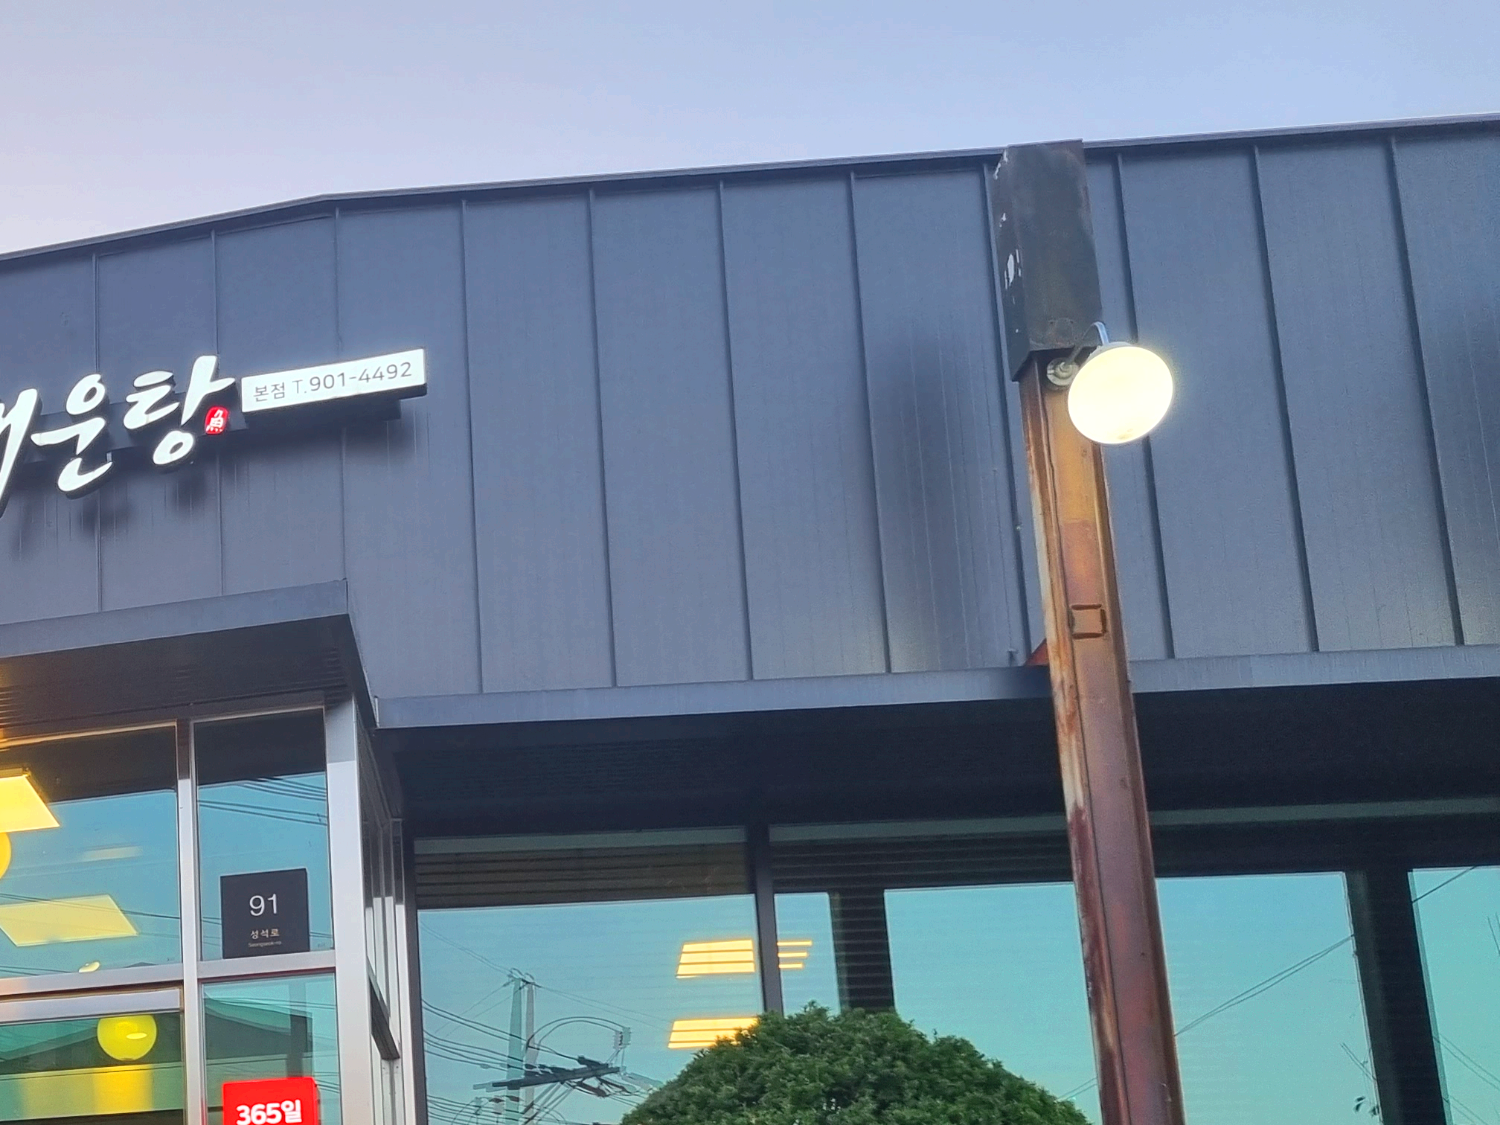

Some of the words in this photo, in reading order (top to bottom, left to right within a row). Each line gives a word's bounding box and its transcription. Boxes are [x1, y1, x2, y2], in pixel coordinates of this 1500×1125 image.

[253, 381, 286, 402] 본점
[249, 893, 277, 917] 91
[251, 928, 280, 940] 성석로
[236, 1099, 302, 1125] 365일
